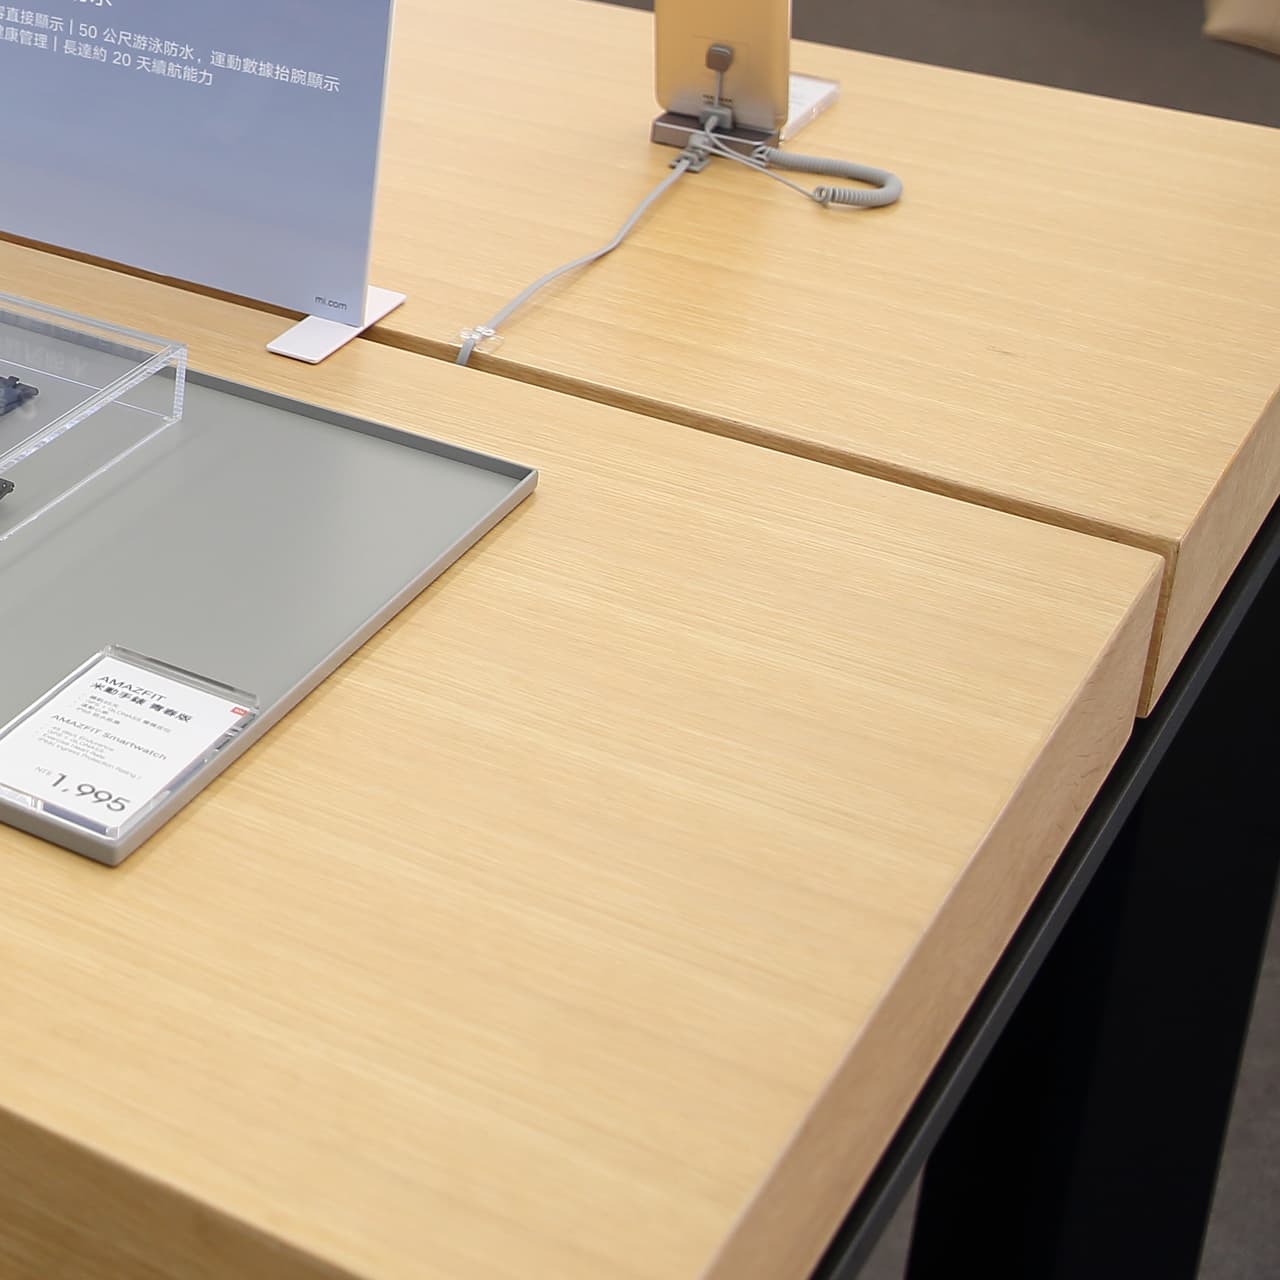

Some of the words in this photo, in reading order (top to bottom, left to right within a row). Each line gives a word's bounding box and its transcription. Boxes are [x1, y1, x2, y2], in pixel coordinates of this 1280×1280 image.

[78, 23, 98, 39] 50
[63, 39, 107, 63] 長達約
[112, 50, 132, 67] 20
[136, 55, 214, 87] 天續航能力
[314, 296, 348, 311] mi.com
[97, 676, 167, 701] AMAZFIT
[51, 714, 102, 734] AMAZFIT
[102, 732, 167, 760] Smartwatch
[52, 772, 131, 812] 1,995
